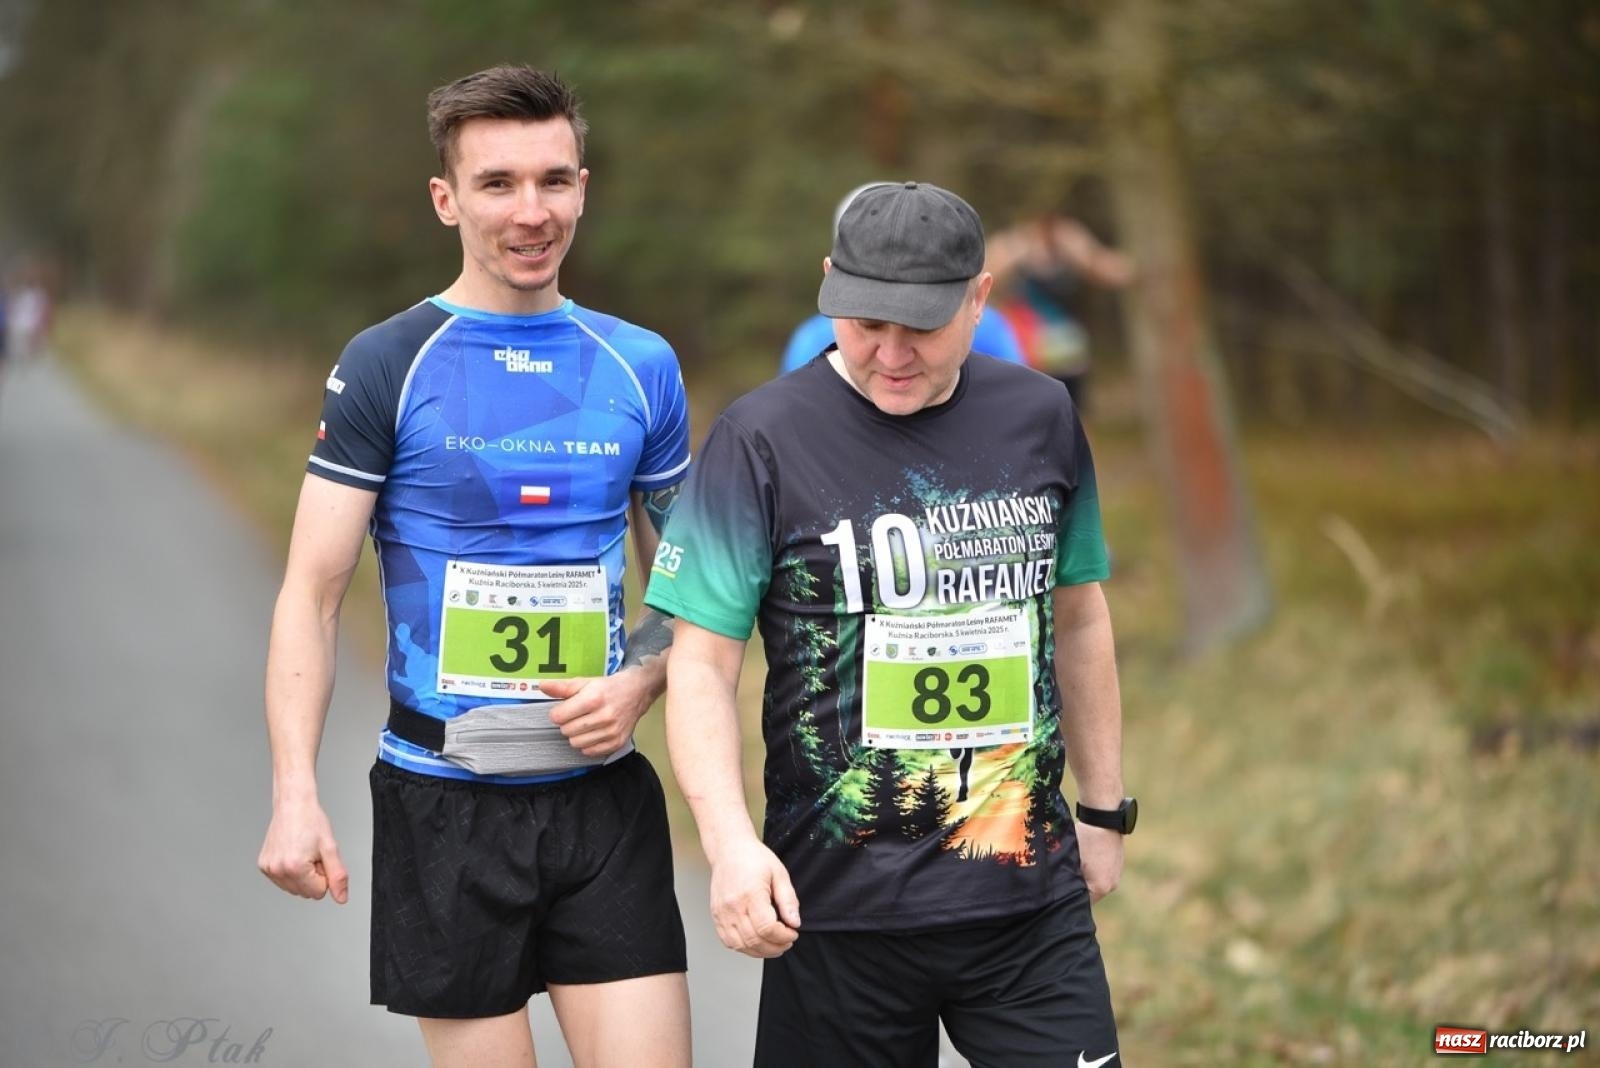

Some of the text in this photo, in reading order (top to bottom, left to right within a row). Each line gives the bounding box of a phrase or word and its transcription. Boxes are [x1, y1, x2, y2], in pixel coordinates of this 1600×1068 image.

[506, 360, 552, 373] okna
[564, 441, 620, 456] TEAM
[925, 492, 1053, 534] KUŹNIAŃSKI
[654, 541, 684, 572] 25
[820, 513, 926, 613] 10
[934, 534, 1026, 561] PÓŁMARATON
[938, 558, 1054, 606] RAFAMET
[960, 627, 987, 636] kwietnia
[988, 626, 1004, 634] 2025
[985, 615, 1017, 625] RAFAMET
[489, 616, 567, 673] 31
[912, 664, 991, 724] 83
